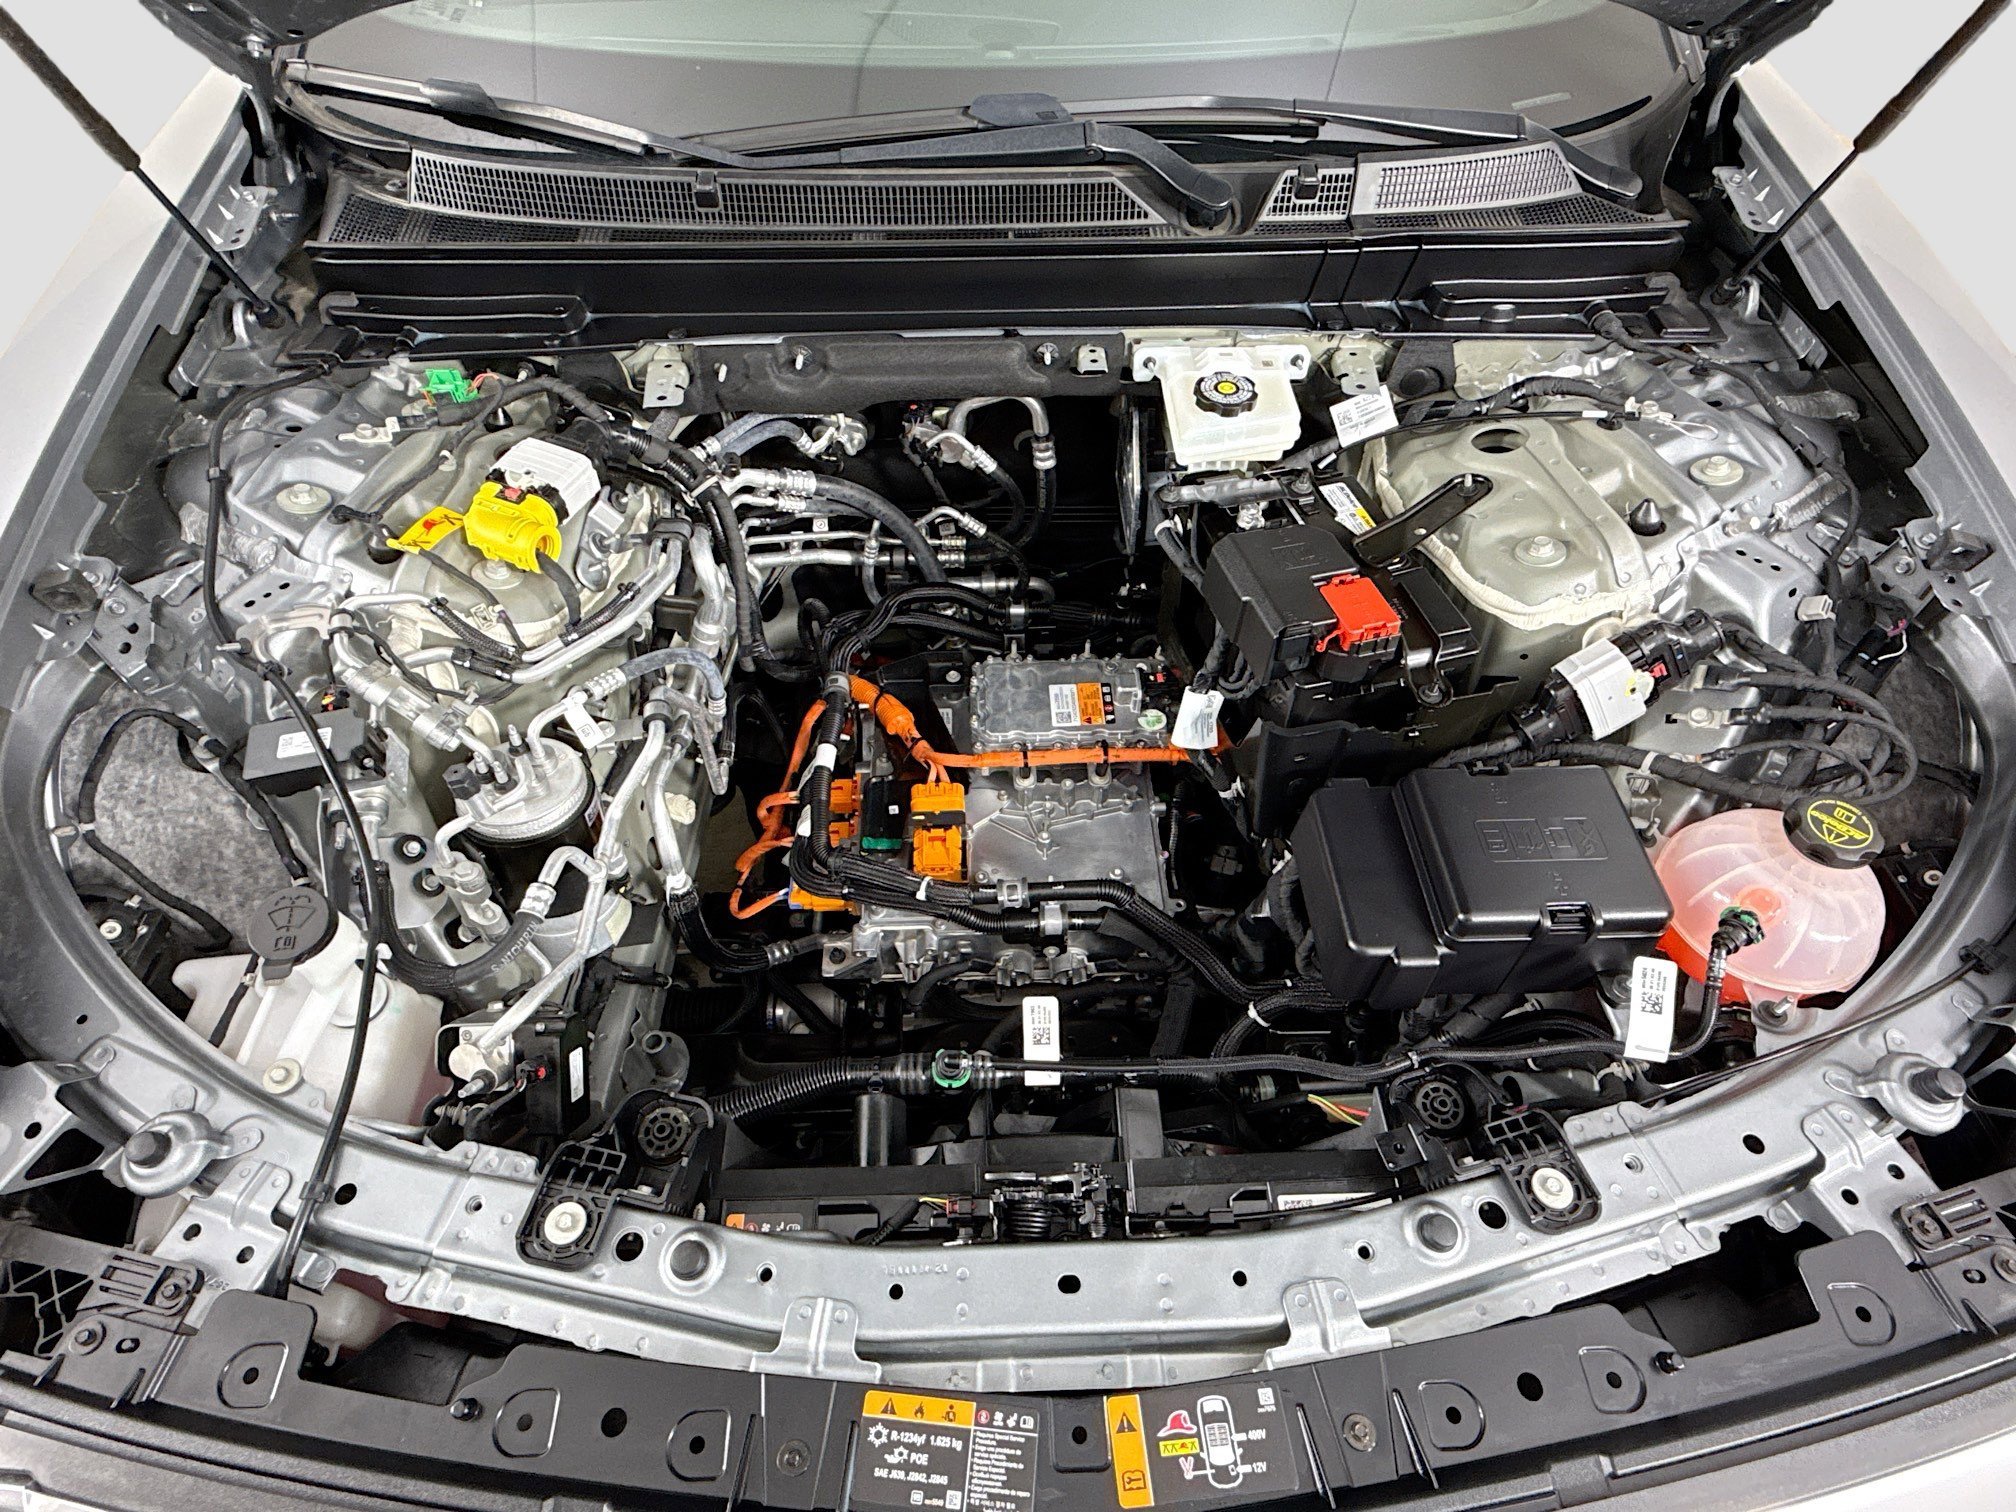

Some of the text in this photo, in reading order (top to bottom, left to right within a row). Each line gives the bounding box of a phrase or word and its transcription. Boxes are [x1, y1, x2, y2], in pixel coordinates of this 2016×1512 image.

[1248, 1428, 1266, 1440] 400V
[890, 1430, 963, 1452] R-1234yf 1.625 kg
[910, 1452, 929, 1466] POE
[874, 1467, 889, 1478] SAE
[1252, 1461, 1267, 1473] 12V
